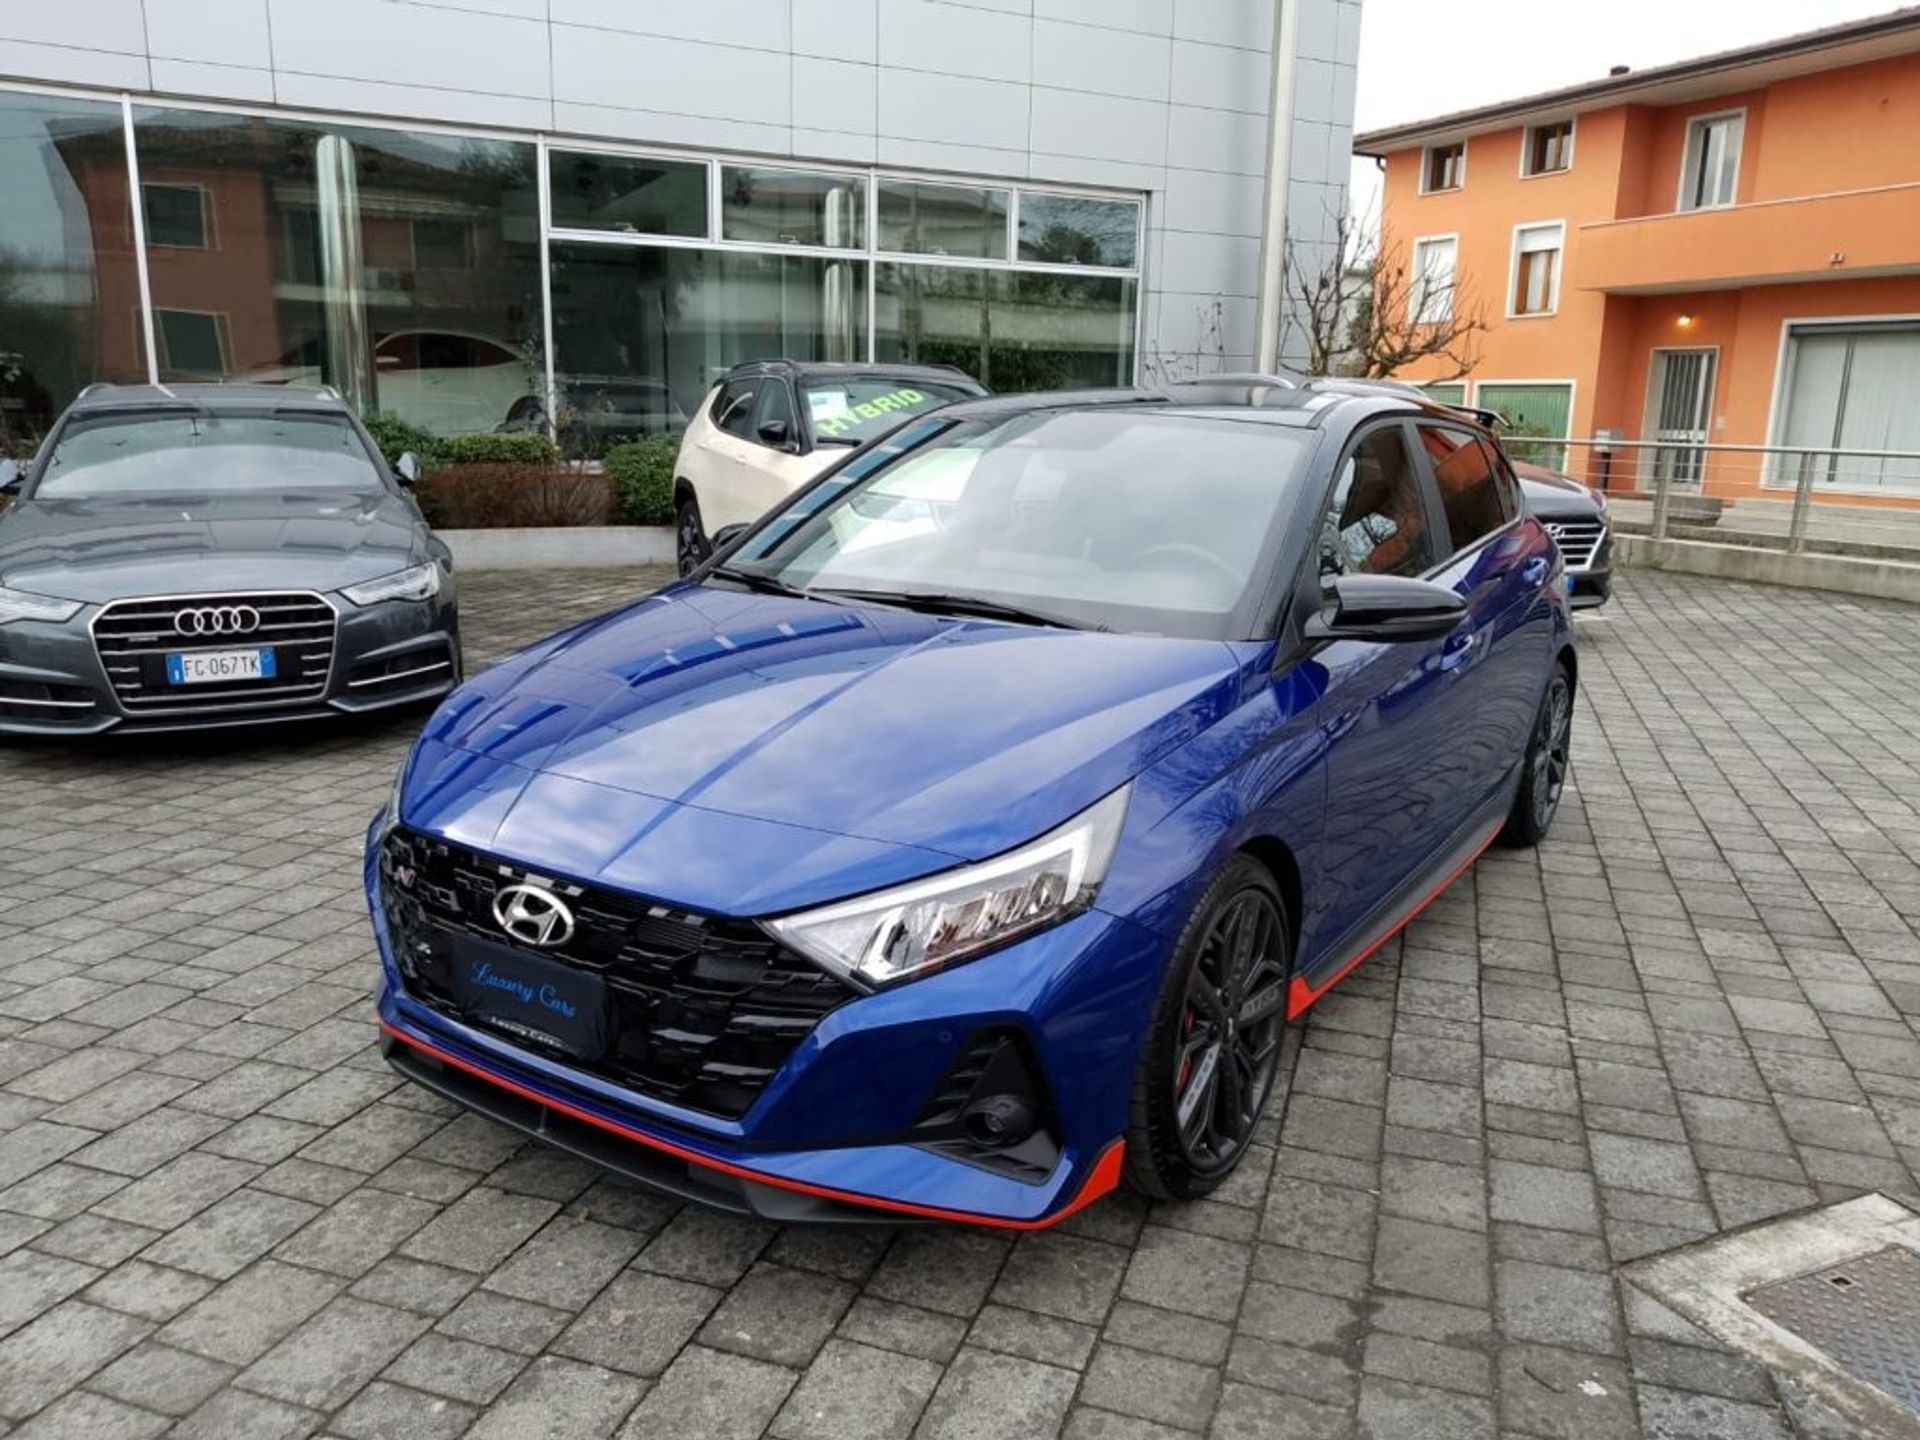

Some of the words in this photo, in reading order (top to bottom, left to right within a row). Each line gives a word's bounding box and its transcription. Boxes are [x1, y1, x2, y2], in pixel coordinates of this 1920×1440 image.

[816, 389, 924, 437] HYBRID
[471, 960, 534, 1003] Luxury
[539, 983, 577, 1018] Cars
